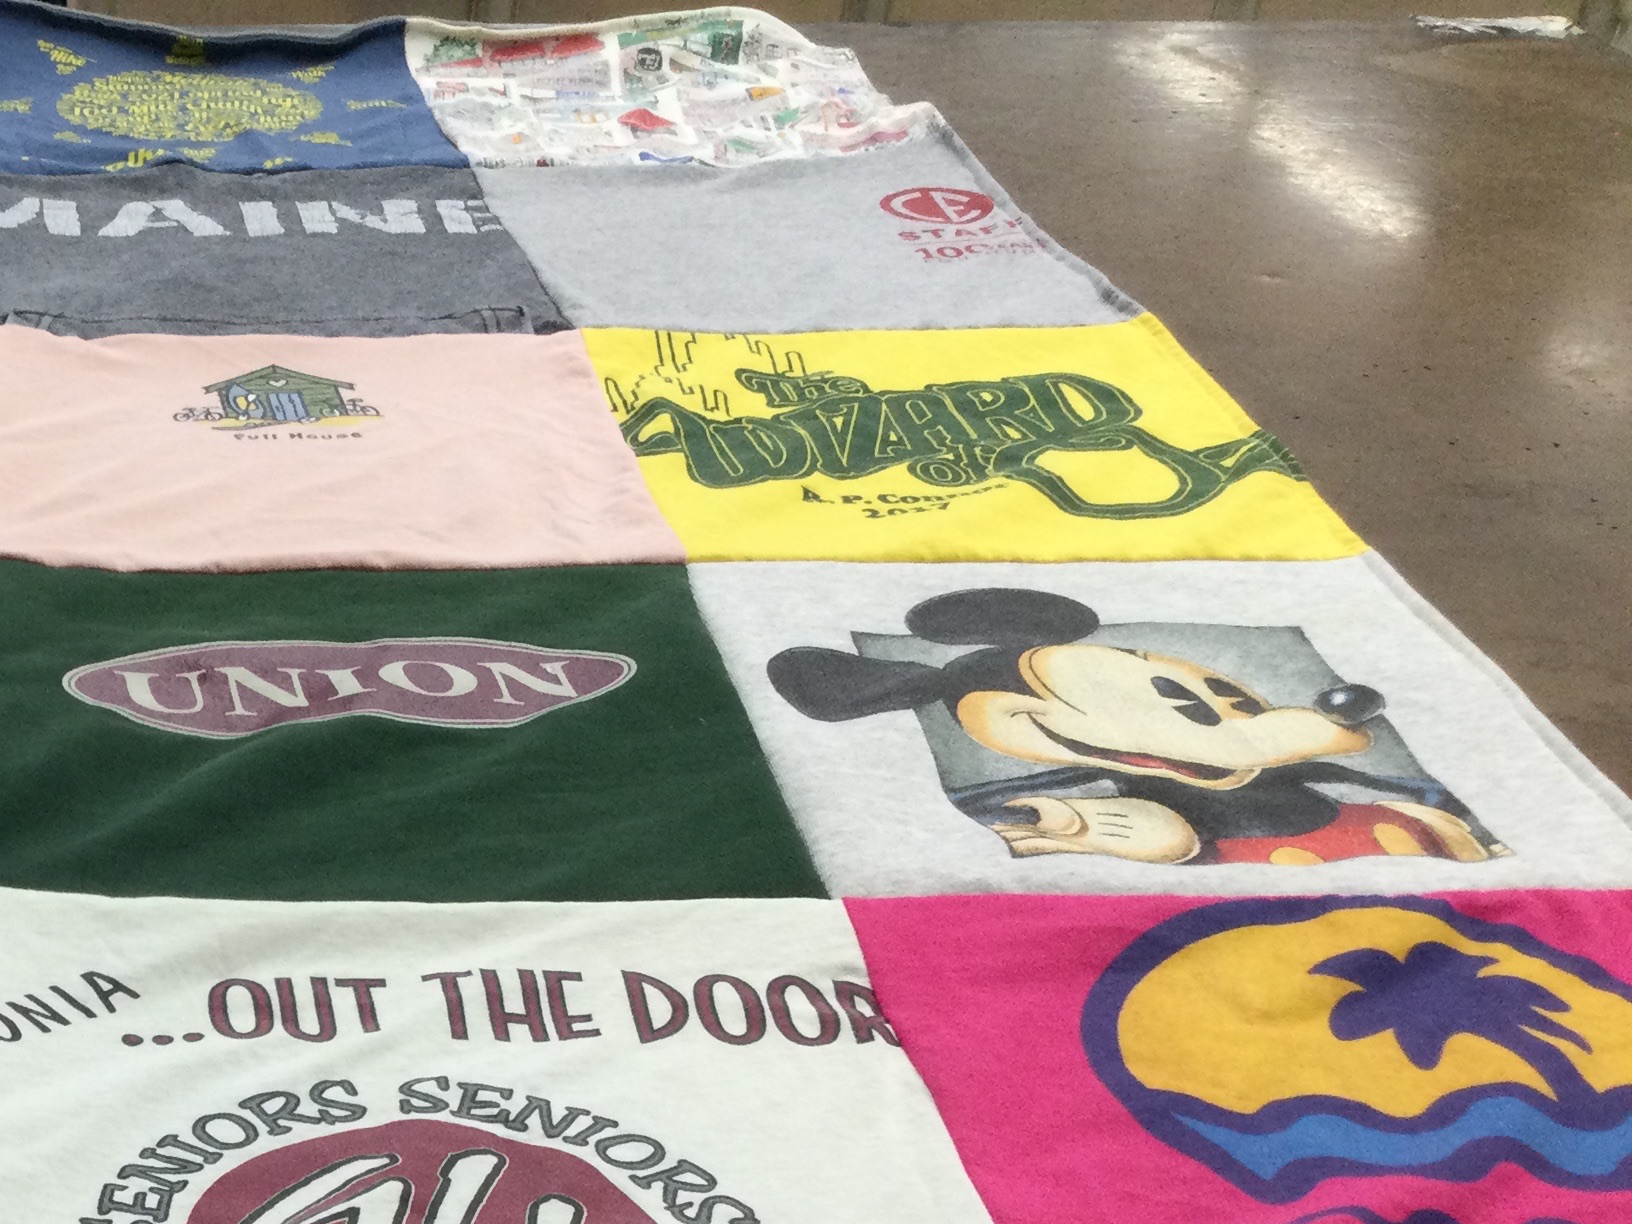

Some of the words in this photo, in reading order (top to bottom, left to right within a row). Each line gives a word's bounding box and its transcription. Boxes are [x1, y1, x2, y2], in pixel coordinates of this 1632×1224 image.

[114, 658, 580, 717] UNION
[420, 968, 601, 1043] THE
[620, 969, 902, 1047] DOOR
